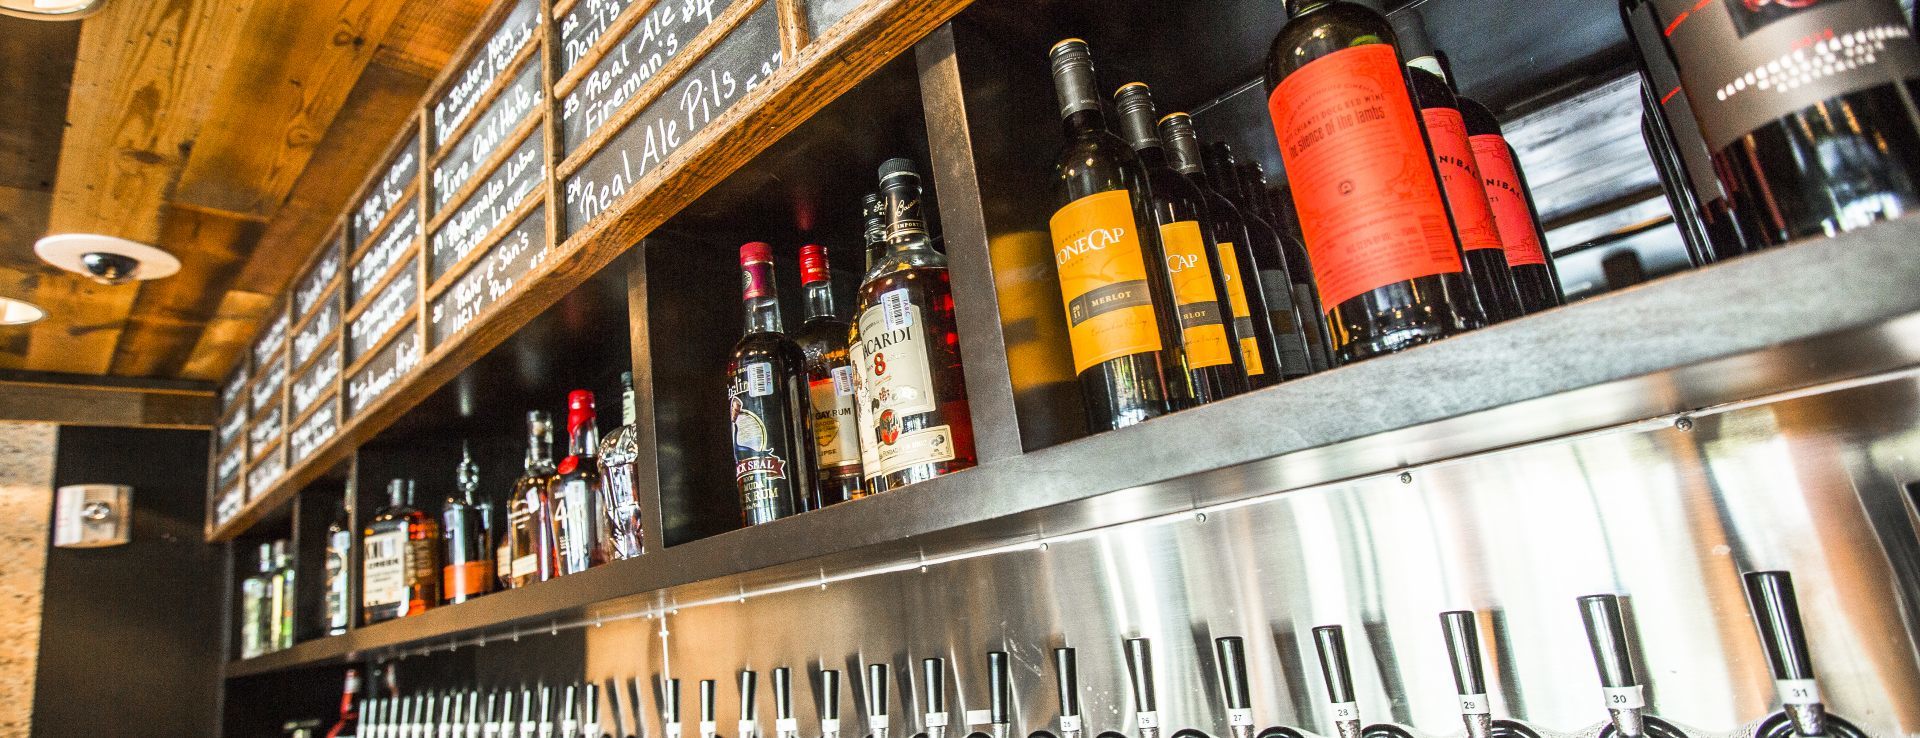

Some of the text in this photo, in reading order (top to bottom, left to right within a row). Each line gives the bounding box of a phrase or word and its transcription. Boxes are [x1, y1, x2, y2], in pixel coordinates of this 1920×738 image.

[562, 13, 580, 40] 22
[565, 1, 621, 71] Devil's
[563, 5, 677, 121] 23 Real Ale
[585, 32, 679, 138] Fireman's
[1297, 126, 1325, 154] silence
[1324, 118, 1336, 137] of
[1336, 111, 1354, 131] the
[1354, 104, 1386, 125] lambs
[442, 160, 469, 204] Live
[472, 116, 498, 164] Oak
[499, 83, 532, 137] Hefe
[567, 176, 582, 204] 24
[580, 149, 633, 223] Real
[640, 117, 681, 177] Ale
[680, 69, 736, 132] Pils
[506, 148, 536, 188] Lobo
[1438, 155, 1477, 179] NIBAL
[1486, 178, 1521, 200] NIBAL
[1091, 290, 1132, 307] MERLOT
[1182, 310, 1207, 320] RLOT
[862, 326, 912, 361] ACARDI
[873, 352, 887, 377] 8
[832, 407, 852, 417] RUM
[747, 459, 775, 471] SEAL
[744, 481, 766, 492] MUDA
[753, 487, 780, 501] RUM
[1612, 694, 1627, 703] 30
[1792, 687, 1808, 698] 31
[1338, 708, 1349, 717] 28
[1463, 701, 1476, 710] 29
[1233, 714, 1243, 722] 27
